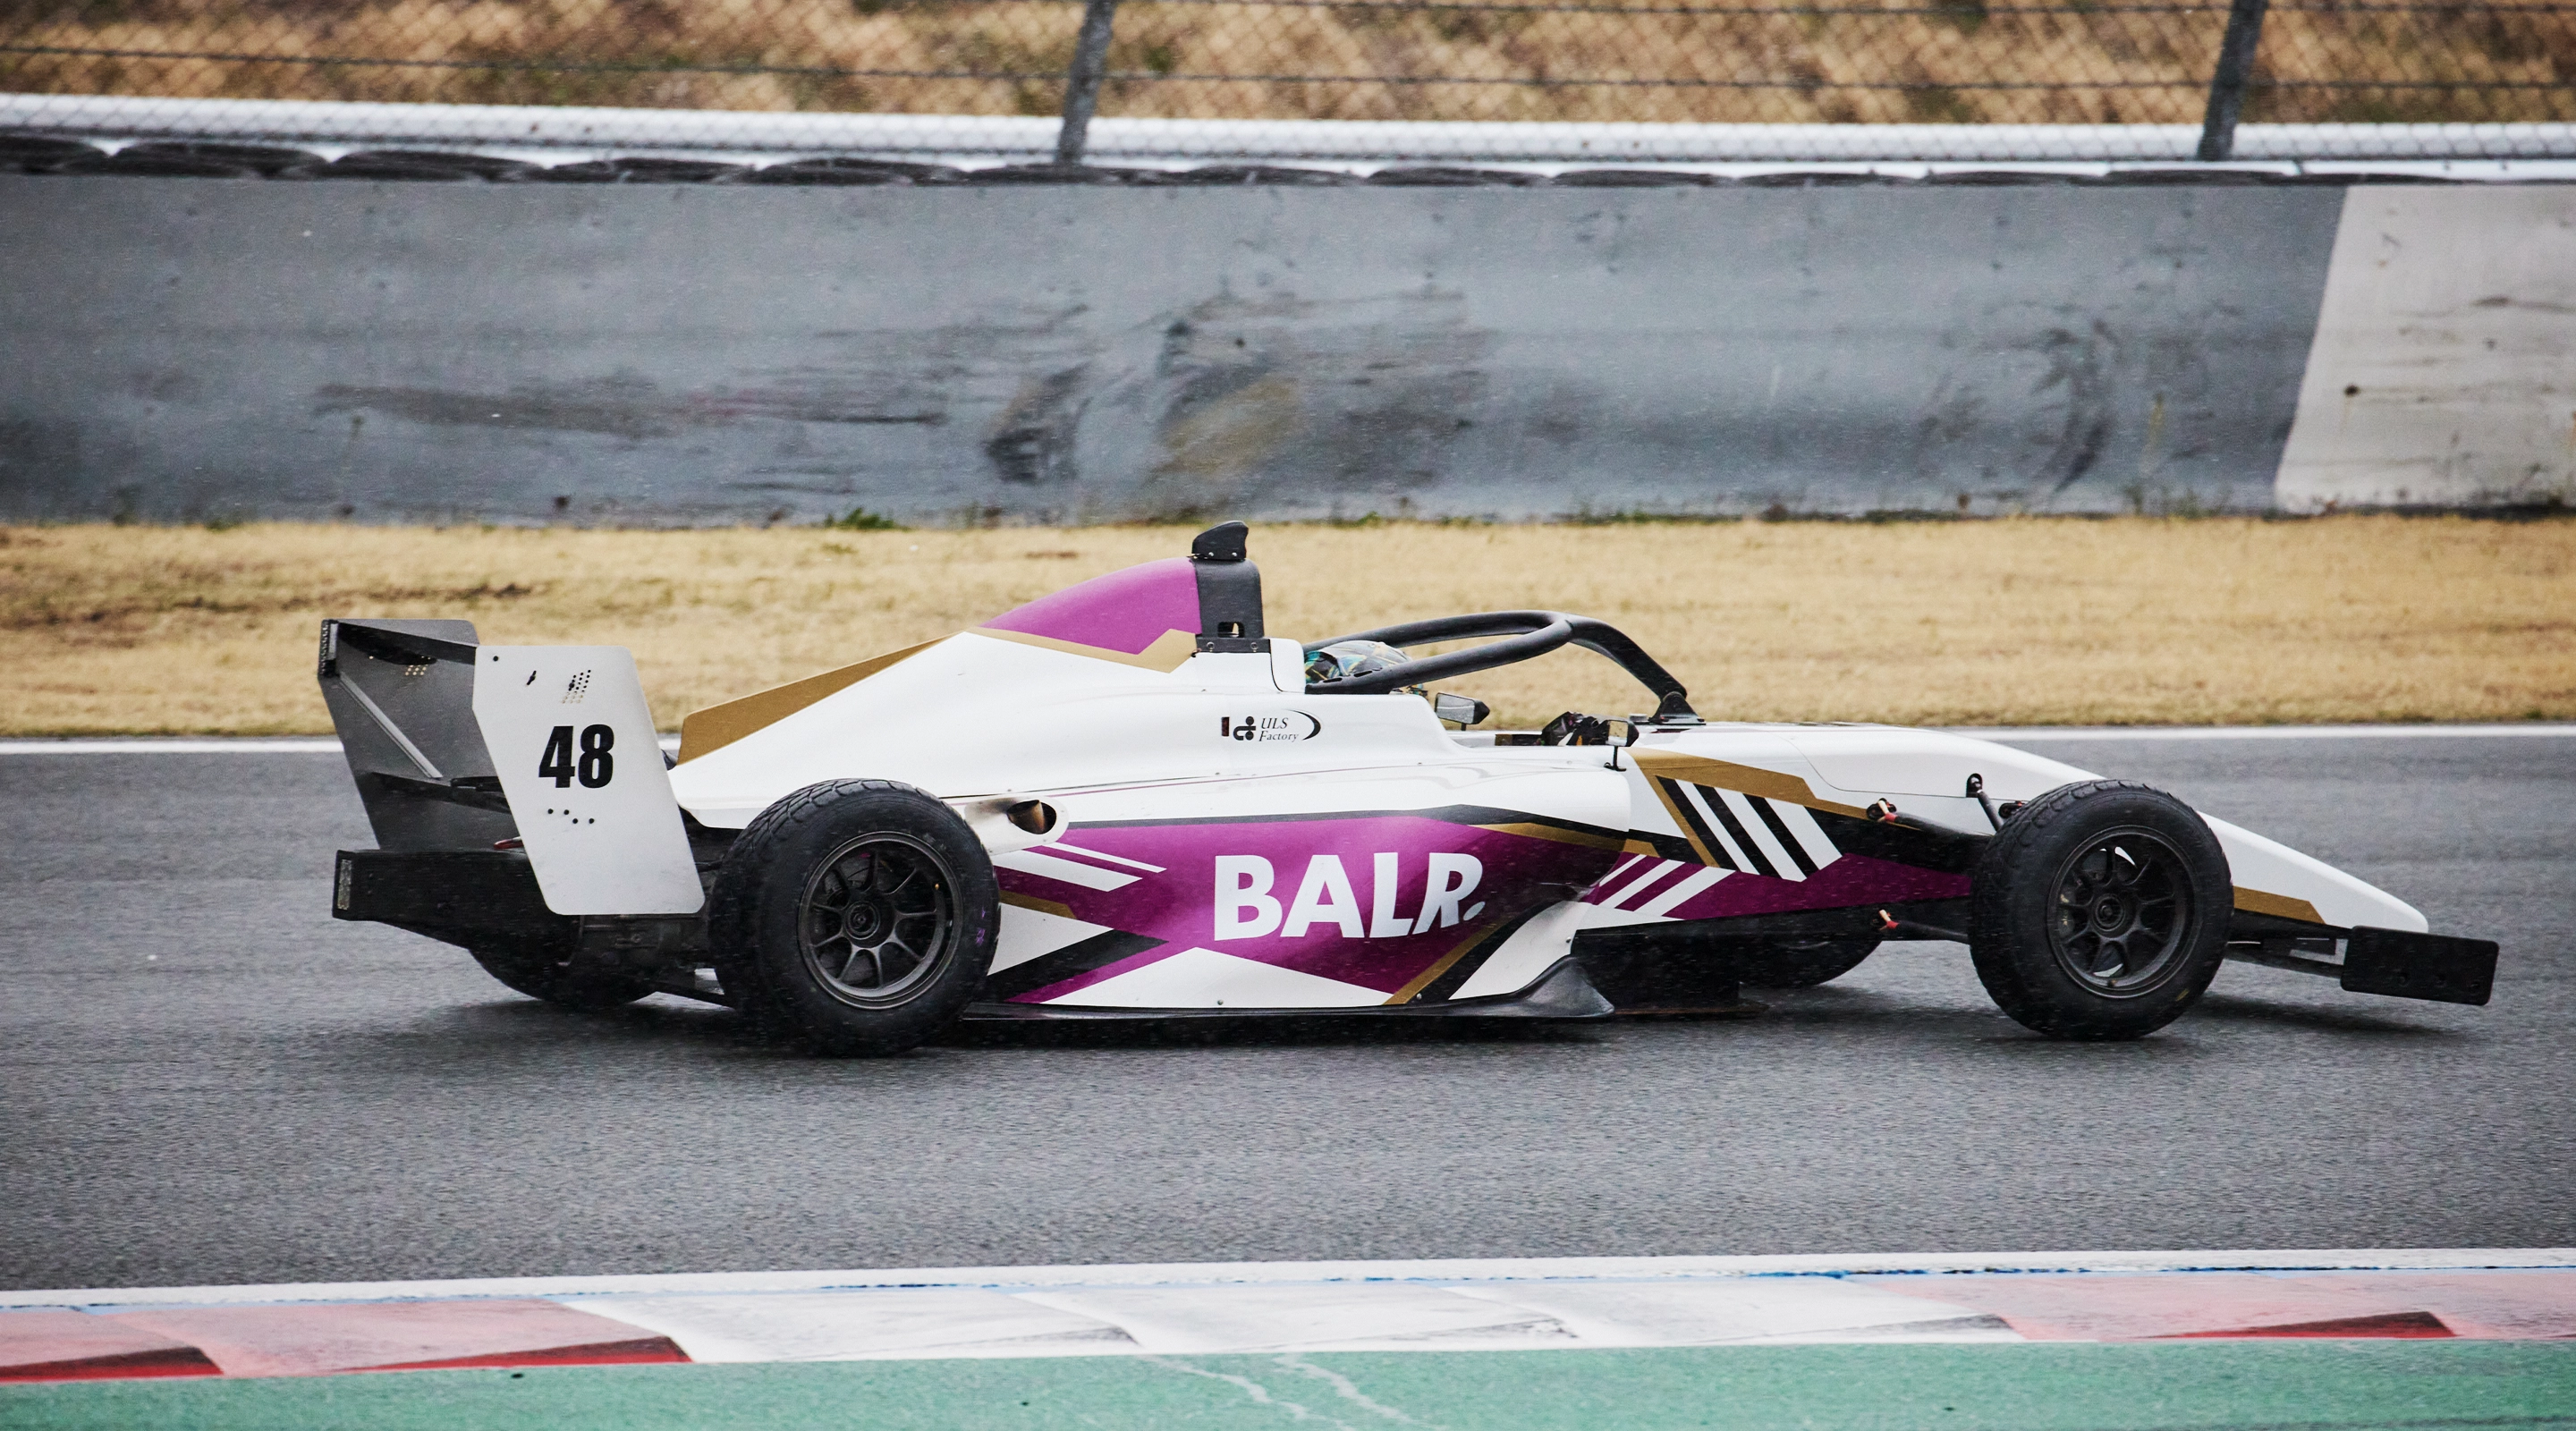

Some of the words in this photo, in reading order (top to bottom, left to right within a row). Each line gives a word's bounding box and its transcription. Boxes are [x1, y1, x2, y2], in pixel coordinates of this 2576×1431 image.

[1258, 730, 1299, 742] Factory
[1260, 717, 1289, 730] ULS
[538, 724, 614, 789] 48
[1214, 851, 1486, 941] BALR.
